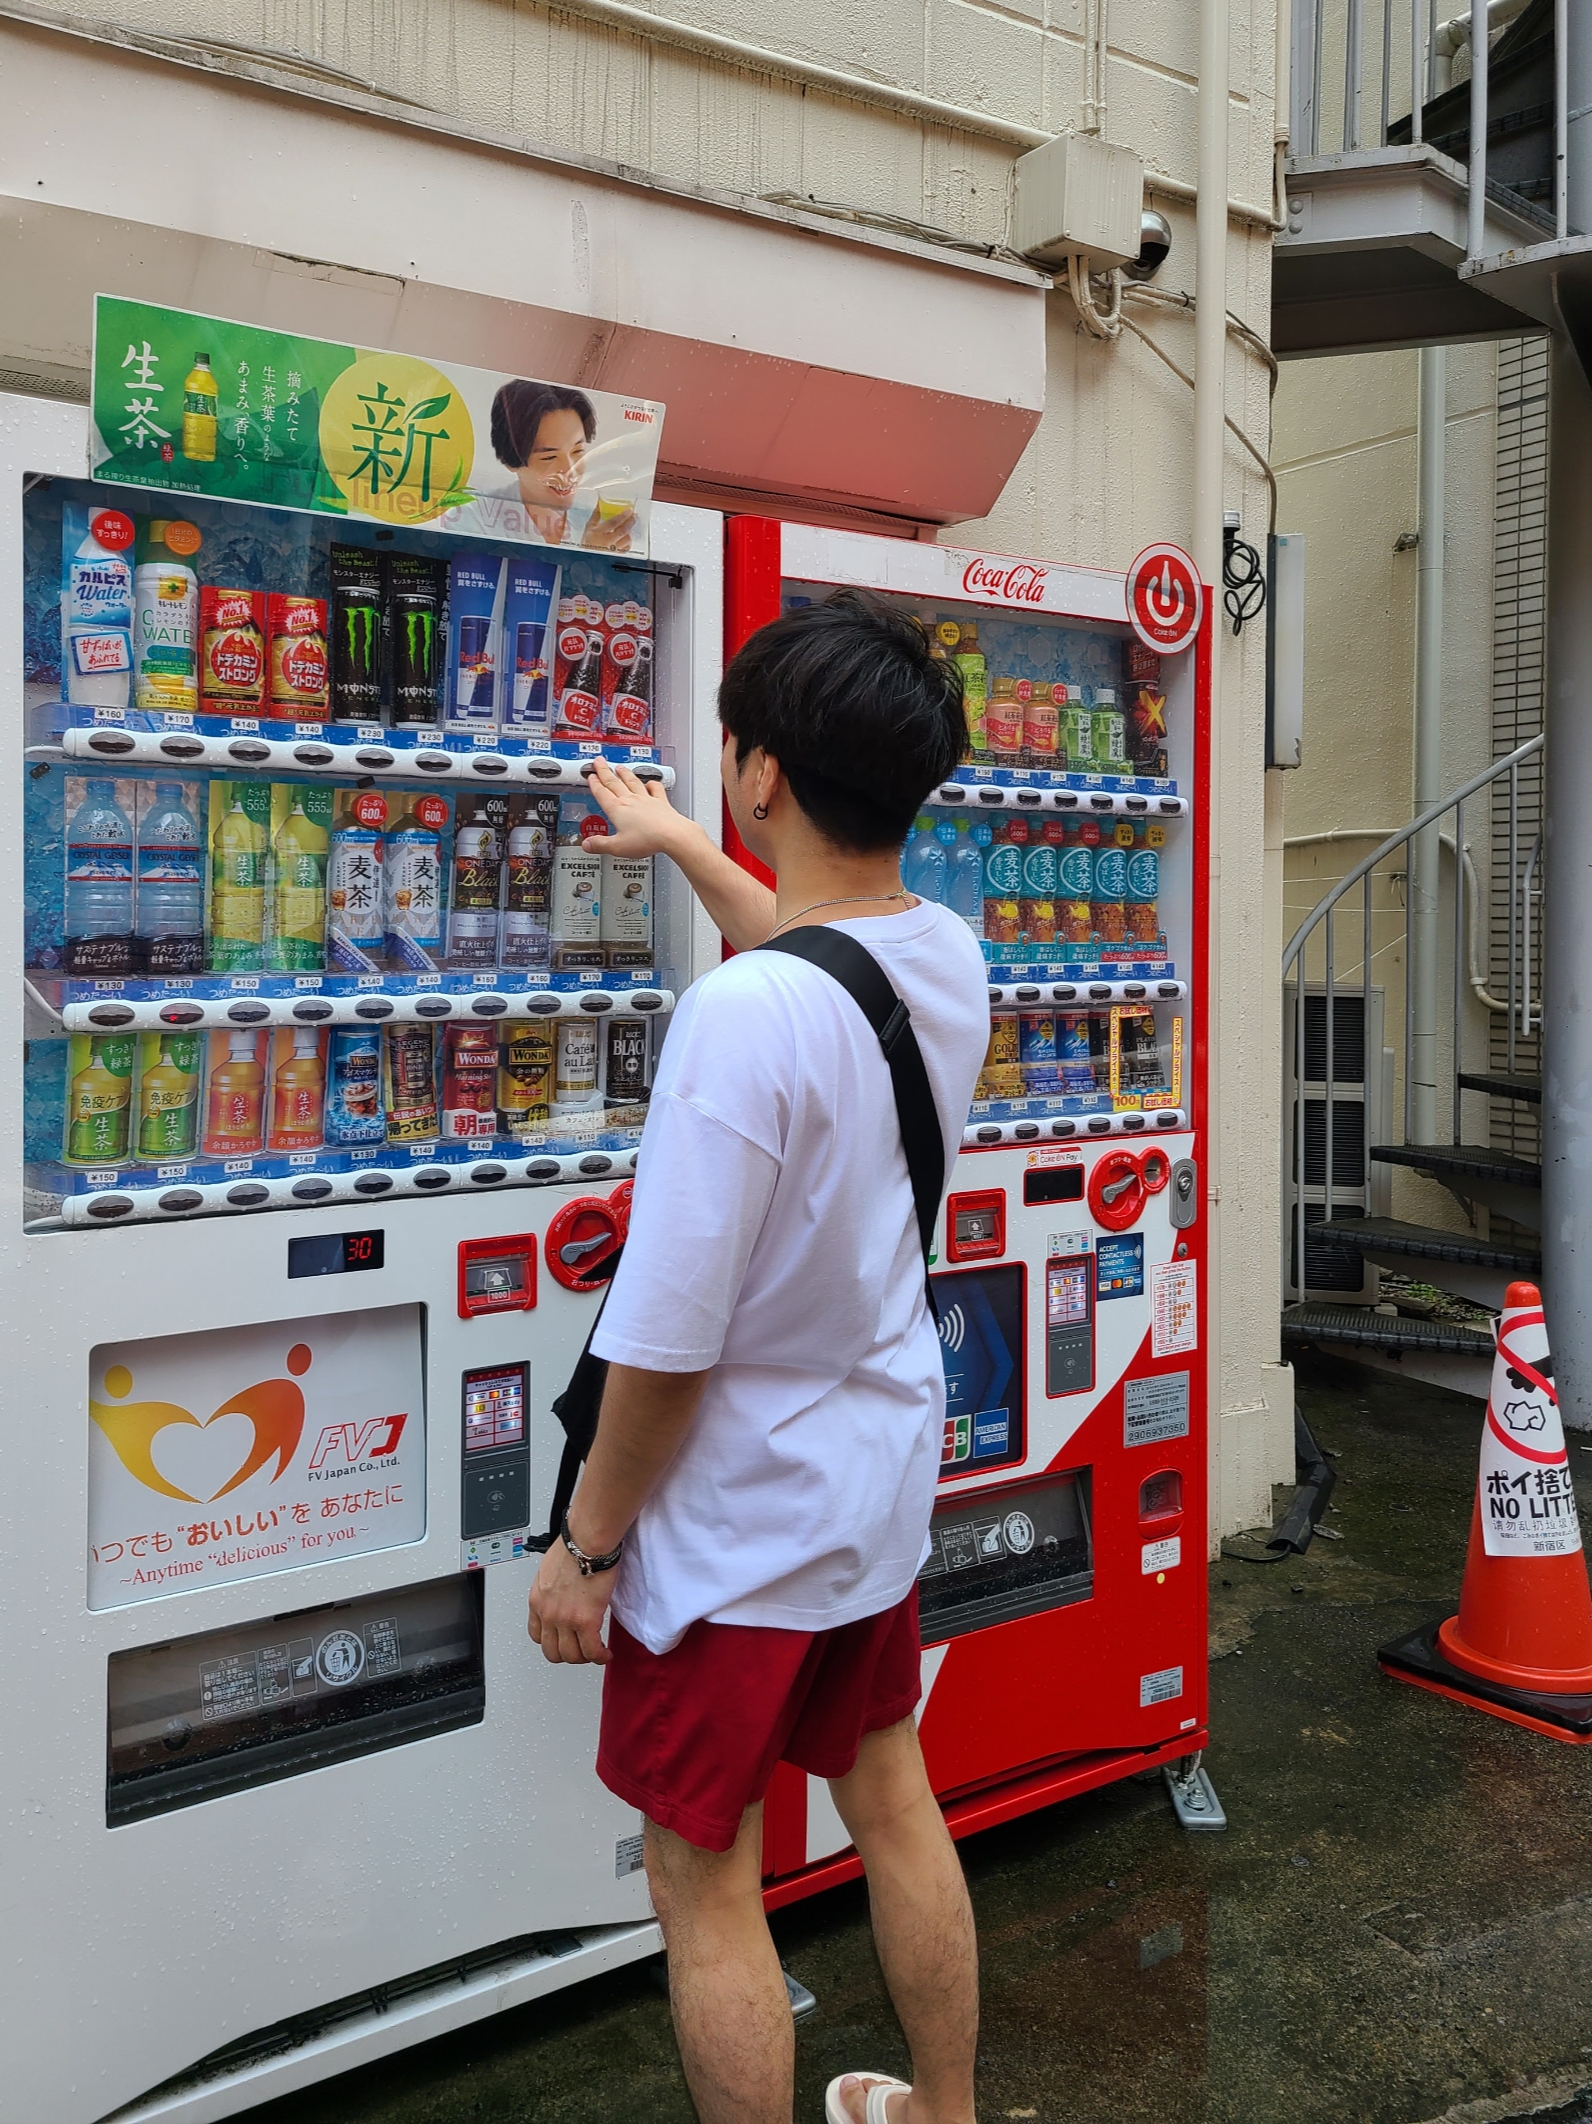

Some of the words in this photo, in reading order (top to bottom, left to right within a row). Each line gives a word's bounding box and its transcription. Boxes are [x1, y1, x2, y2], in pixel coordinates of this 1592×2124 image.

[118, 340, 172, 449] 生茶
[286, 371, 301, 432] 摘みたて
[234, 361, 250, 471] あまみ、香りへ。
[260, 366, 276, 462] 生茶葉のような
[624, 410, 654, 424] KIRIN
[347, 381, 451, 502] 新
[476, 497, 572, 540] Value
[79, 571, 127, 586] カルピス
[333, 570, 380, 578] モンスターエナジー
[457, 571, 470, 579] RED
[471, 572, 486, 580] BULL
[963, 558, 1049, 603] Coca-Cola
[528, 579, 542, 587] BULL
[76, 584, 127, 600] Water
[222, 600, 245, 617] No.1
[291, 611, 314, 626] No.1
[217, 653, 258, 668] ドデカミン
[460, 651, 480, 663] Red
[517, 656, 535, 668] Red
[289, 660, 325, 676] ドデカミン
[219, 668, 256, 682] ストロング
[99, 710, 121, 719] ¥160
[168, 715, 190, 724] ¥170
[631, 712, 638, 720] C
[235, 721, 257, 729] ¥140
[298, 725, 320, 733] ¥140
[421, 733, 442, 741] ¥230
[308, 791, 332, 799] たっぷり
[73, 851, 101, 860] CRYSTAL
[147, 852, 176, 861] CRYSTAL
[236, 855, 253, 887] 生茶
[297, 856, 313, 888] 生茶
[1004, 850, 1020, 888] 麦茶
[1040, 852, 1055, 888] 麦茶
[1076, 853, 1091, 889] 麦茶
[1109, 854, 1125, 892] 麦茶
[1141, 855, 1157, 893] 麦茶
[347, 855, 373, 909] 麦茶
[412, 856, 435, 909] 麦茶
[98, 981, 123, 990] ¥130
[167, 980, 192, 988] ¥130
[419, 976, 438, 984] ¥140
[458, 1052, 496, 1065] WONDA
[513, 1049, 549, 1061] WONDA
[111, 1056, 132, 1069] 緑茶
[564, 1059, 577, 1067] au
[455, 1072, 483, 1081] Morning
[232, 1095, 247, 1124] 生茶
[298, 1091, 311, 1119] 生茶
[163, 1113, 182, 1147] 生茶
[454, 1115, 477, 1136] 朝
[93, 1117, 112, 1151] 生茶
[292, 1156, 314, 1164] ¥140
[353, 1151, 375, 1159] ¥130
[1066, 1152, 1078, 1163] Pay
[161, 1167, 185, 1176] ¥150
[227, 1162, 250, 1171] ¥140
[91, 1173, 116, 1182] ¥150
[347, 1236, 373, 1261] 30
[1098, 1250, 1134, 1260] CONTACTLESS
[1099, 1244, 1119, 1253] ACCEPT
[1098, 1258, 1125, 1268] PAYMENTS
[491, 1290, 508, 1299] 1000
[976, 1422, 1007, 1434] AMERICAN
[1128, 1422, 1185, 1441] 2906937350
[981, 1433, 1008, 1443] EXPRESS
[308, 1471, 322, 1482] FV
[324, 1467, 356, 1482] Japan
[359, 1461, 379, 1473] Co.,
[381, 1457, 400, 1468] Ltd.
[1486, 1466, 1573, 1496] ポイ捨て
[321, 1484, 404, 1519] あなたに
[1490, 1497, 1520, 1519] NO
[1492, 1518, 1568, 1531] 请勿乱扔垃圾
[301, 1532, 322, 1549] for
[1533, 1540, 1566, 1552] 新宿区
